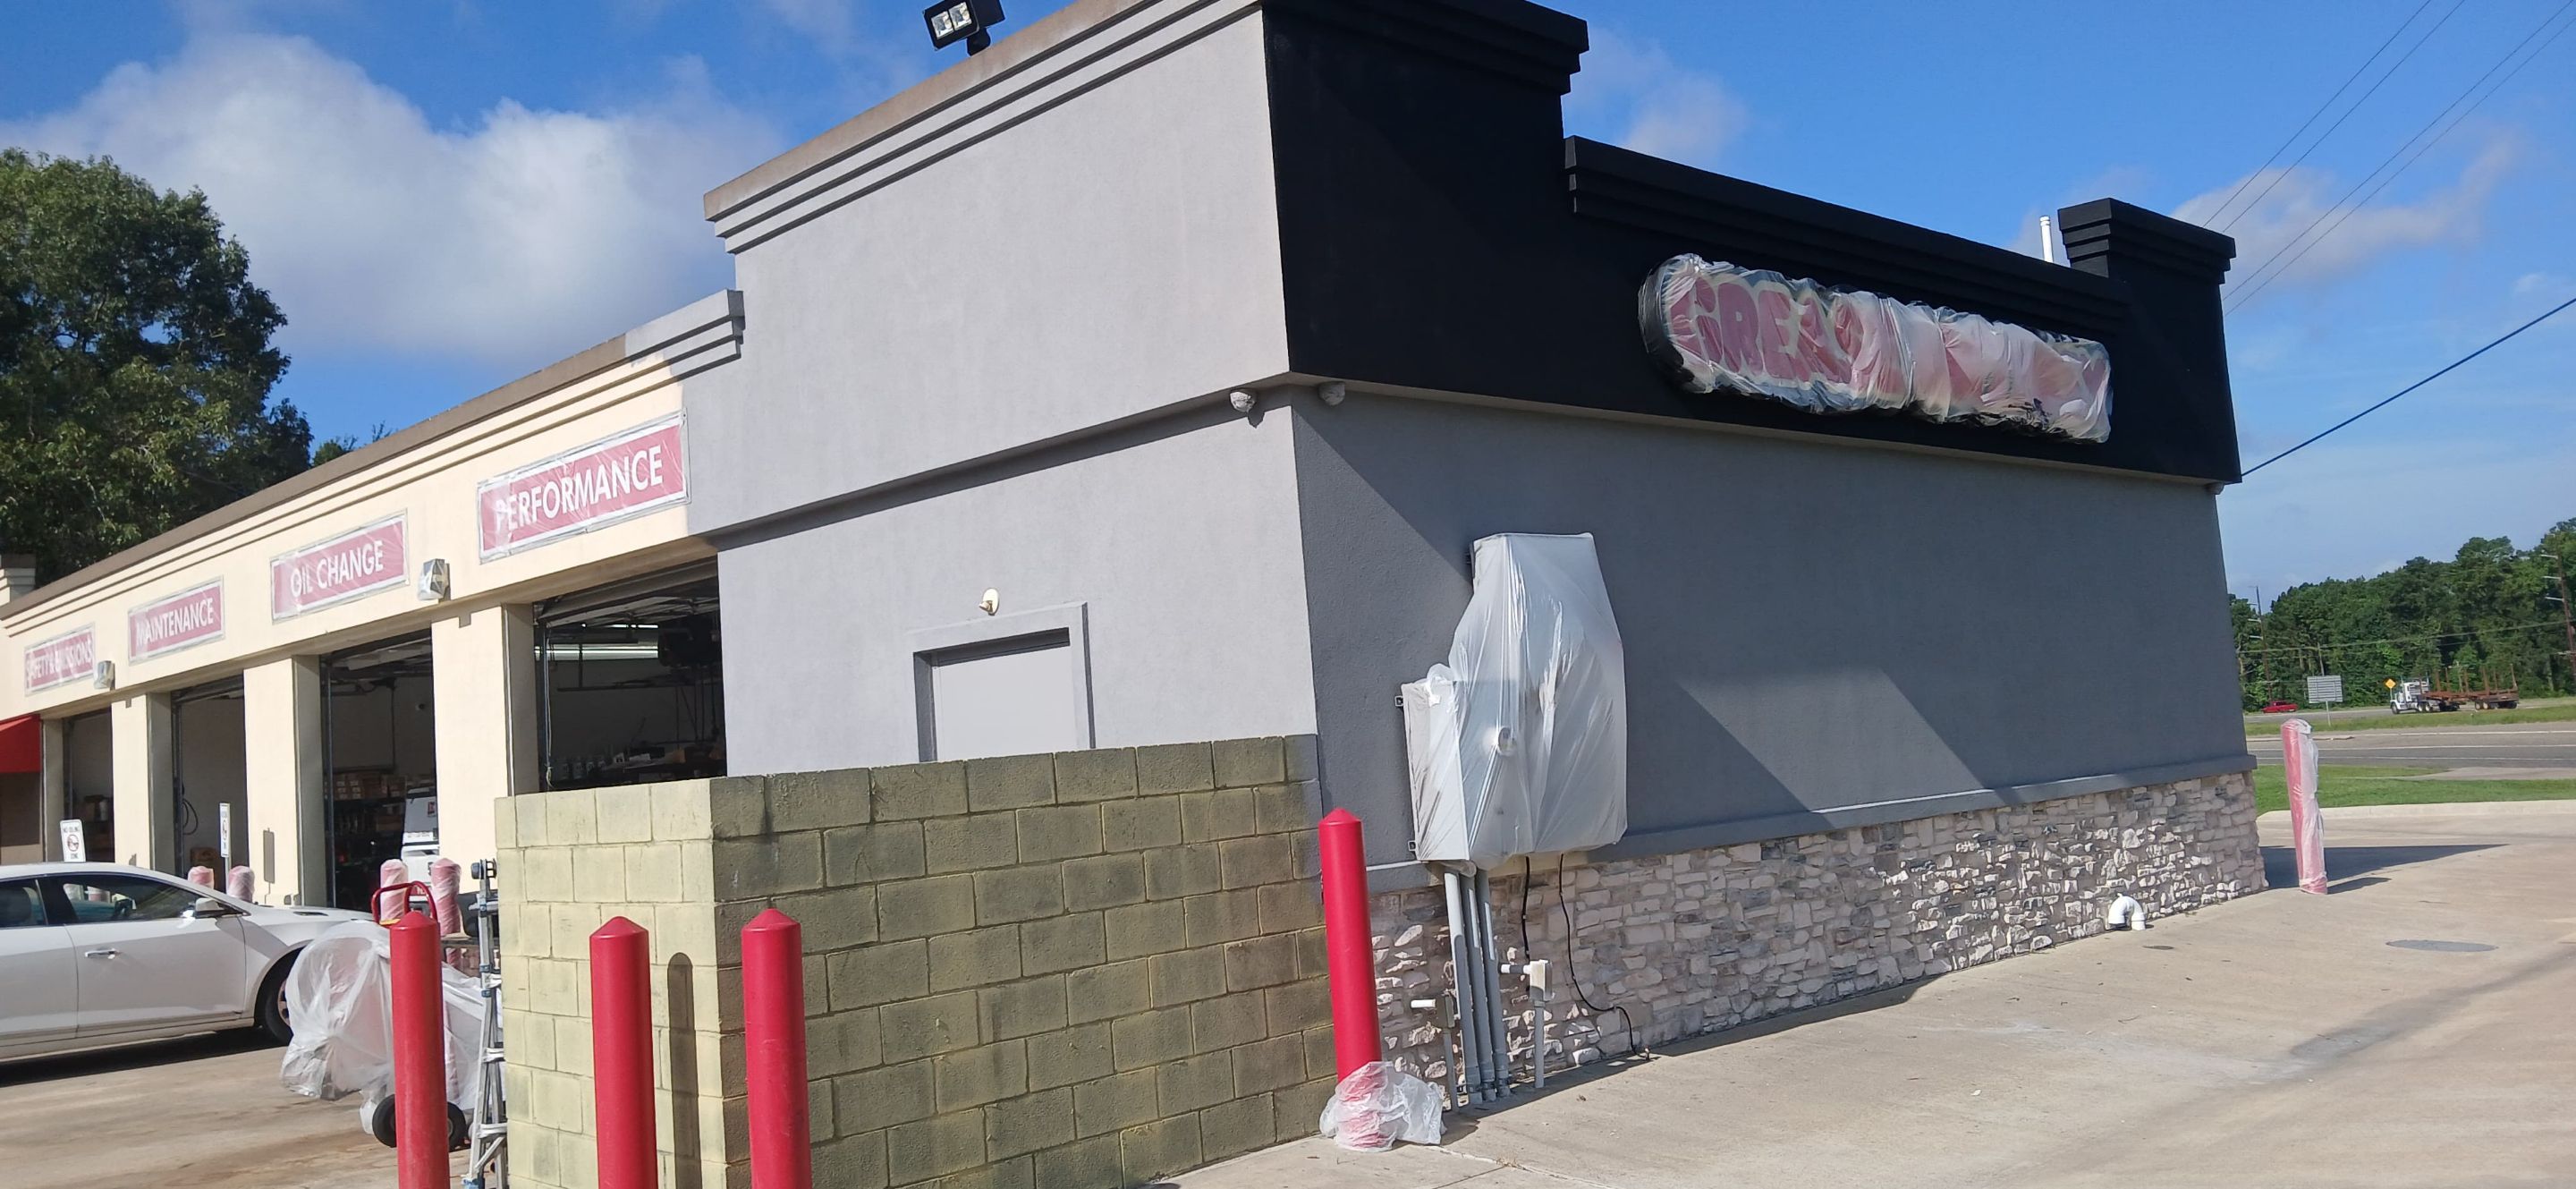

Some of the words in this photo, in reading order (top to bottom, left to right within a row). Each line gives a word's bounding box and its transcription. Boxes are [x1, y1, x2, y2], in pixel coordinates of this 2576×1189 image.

[495, 445, 664, 531] PERFORMANCE
[290, 564, 313, 599] OIL
[316, 539, 384, 590] CHANGE
[136, 597, 214, 648] MAINTENANCE
